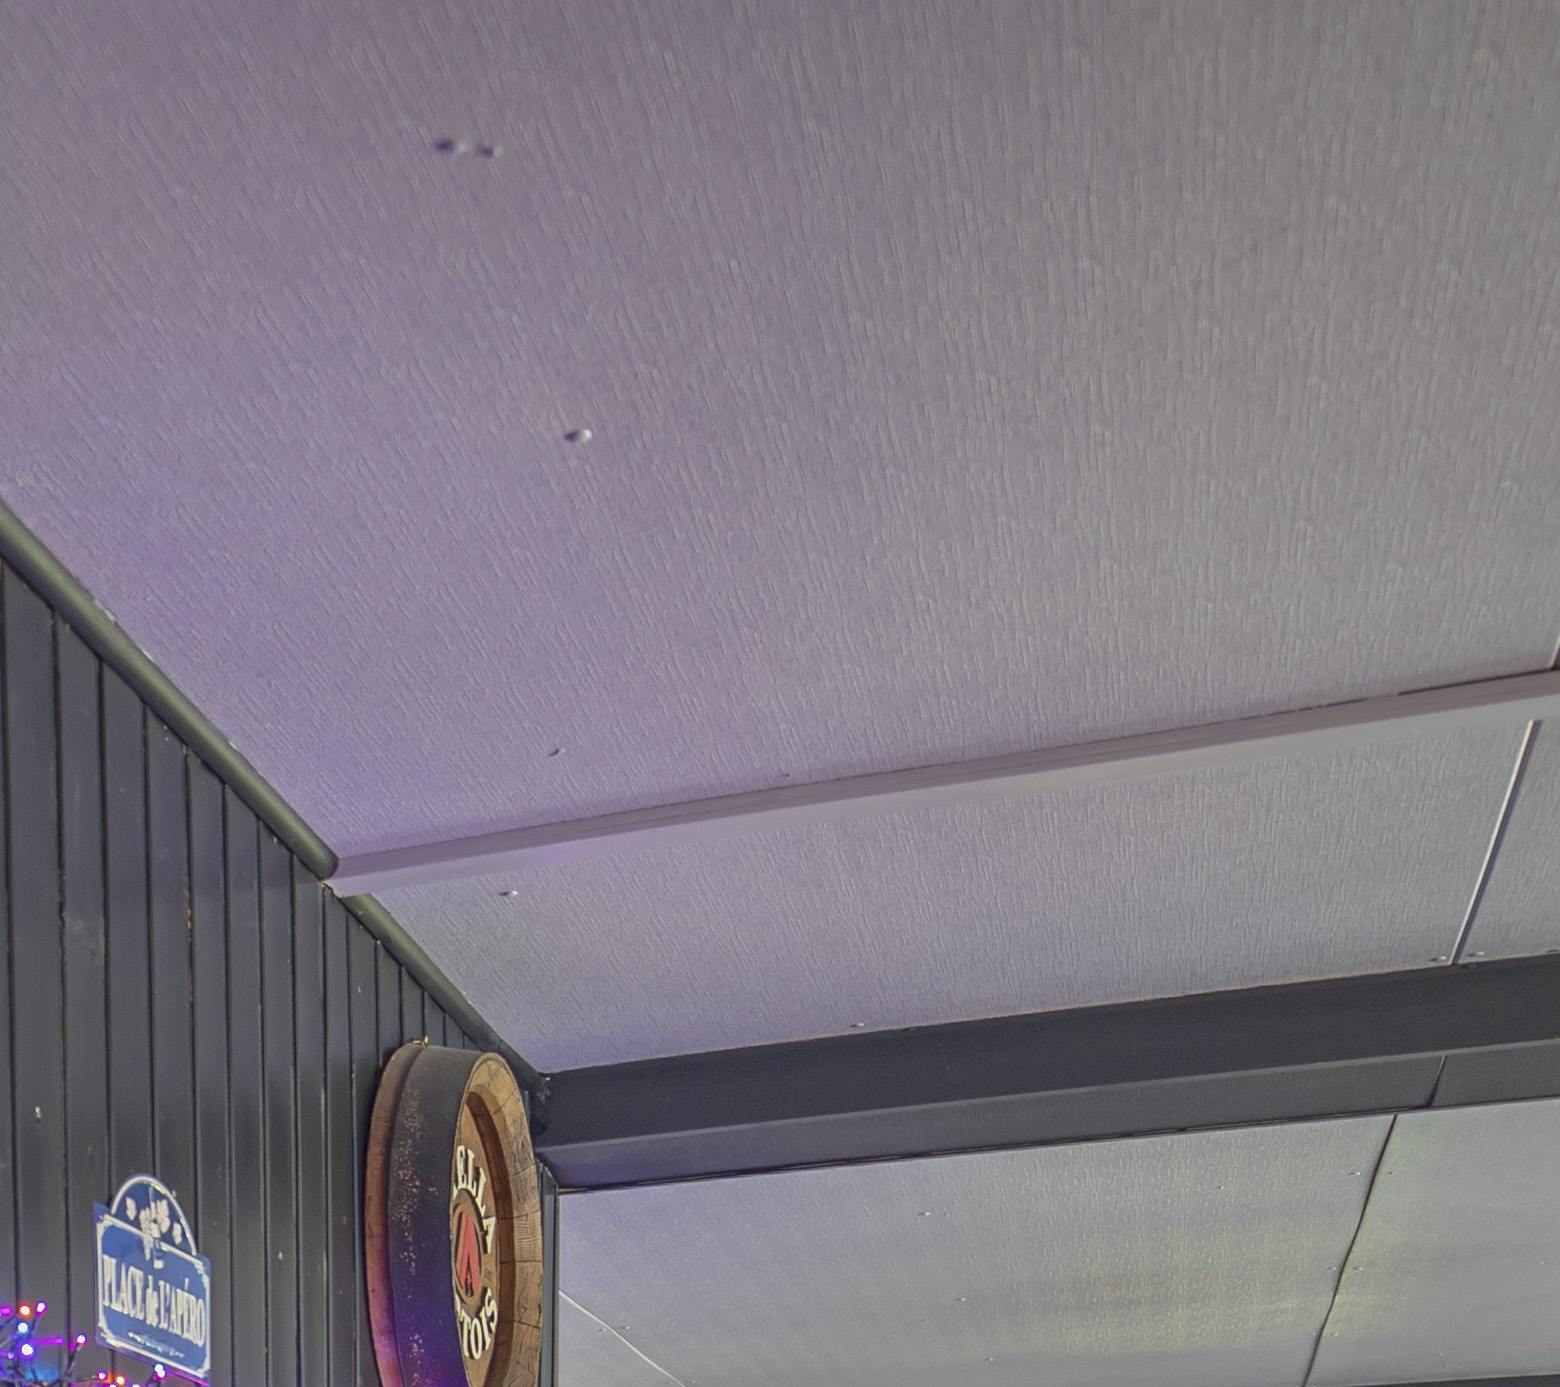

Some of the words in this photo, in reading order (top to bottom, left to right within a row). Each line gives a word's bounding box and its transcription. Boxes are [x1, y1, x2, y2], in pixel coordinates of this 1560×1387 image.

[102, 1254, 144, 1321] PLACE
[146, 1275, 159, 1327] de
[158, 1278, 206, 1348] L'APÉRO
